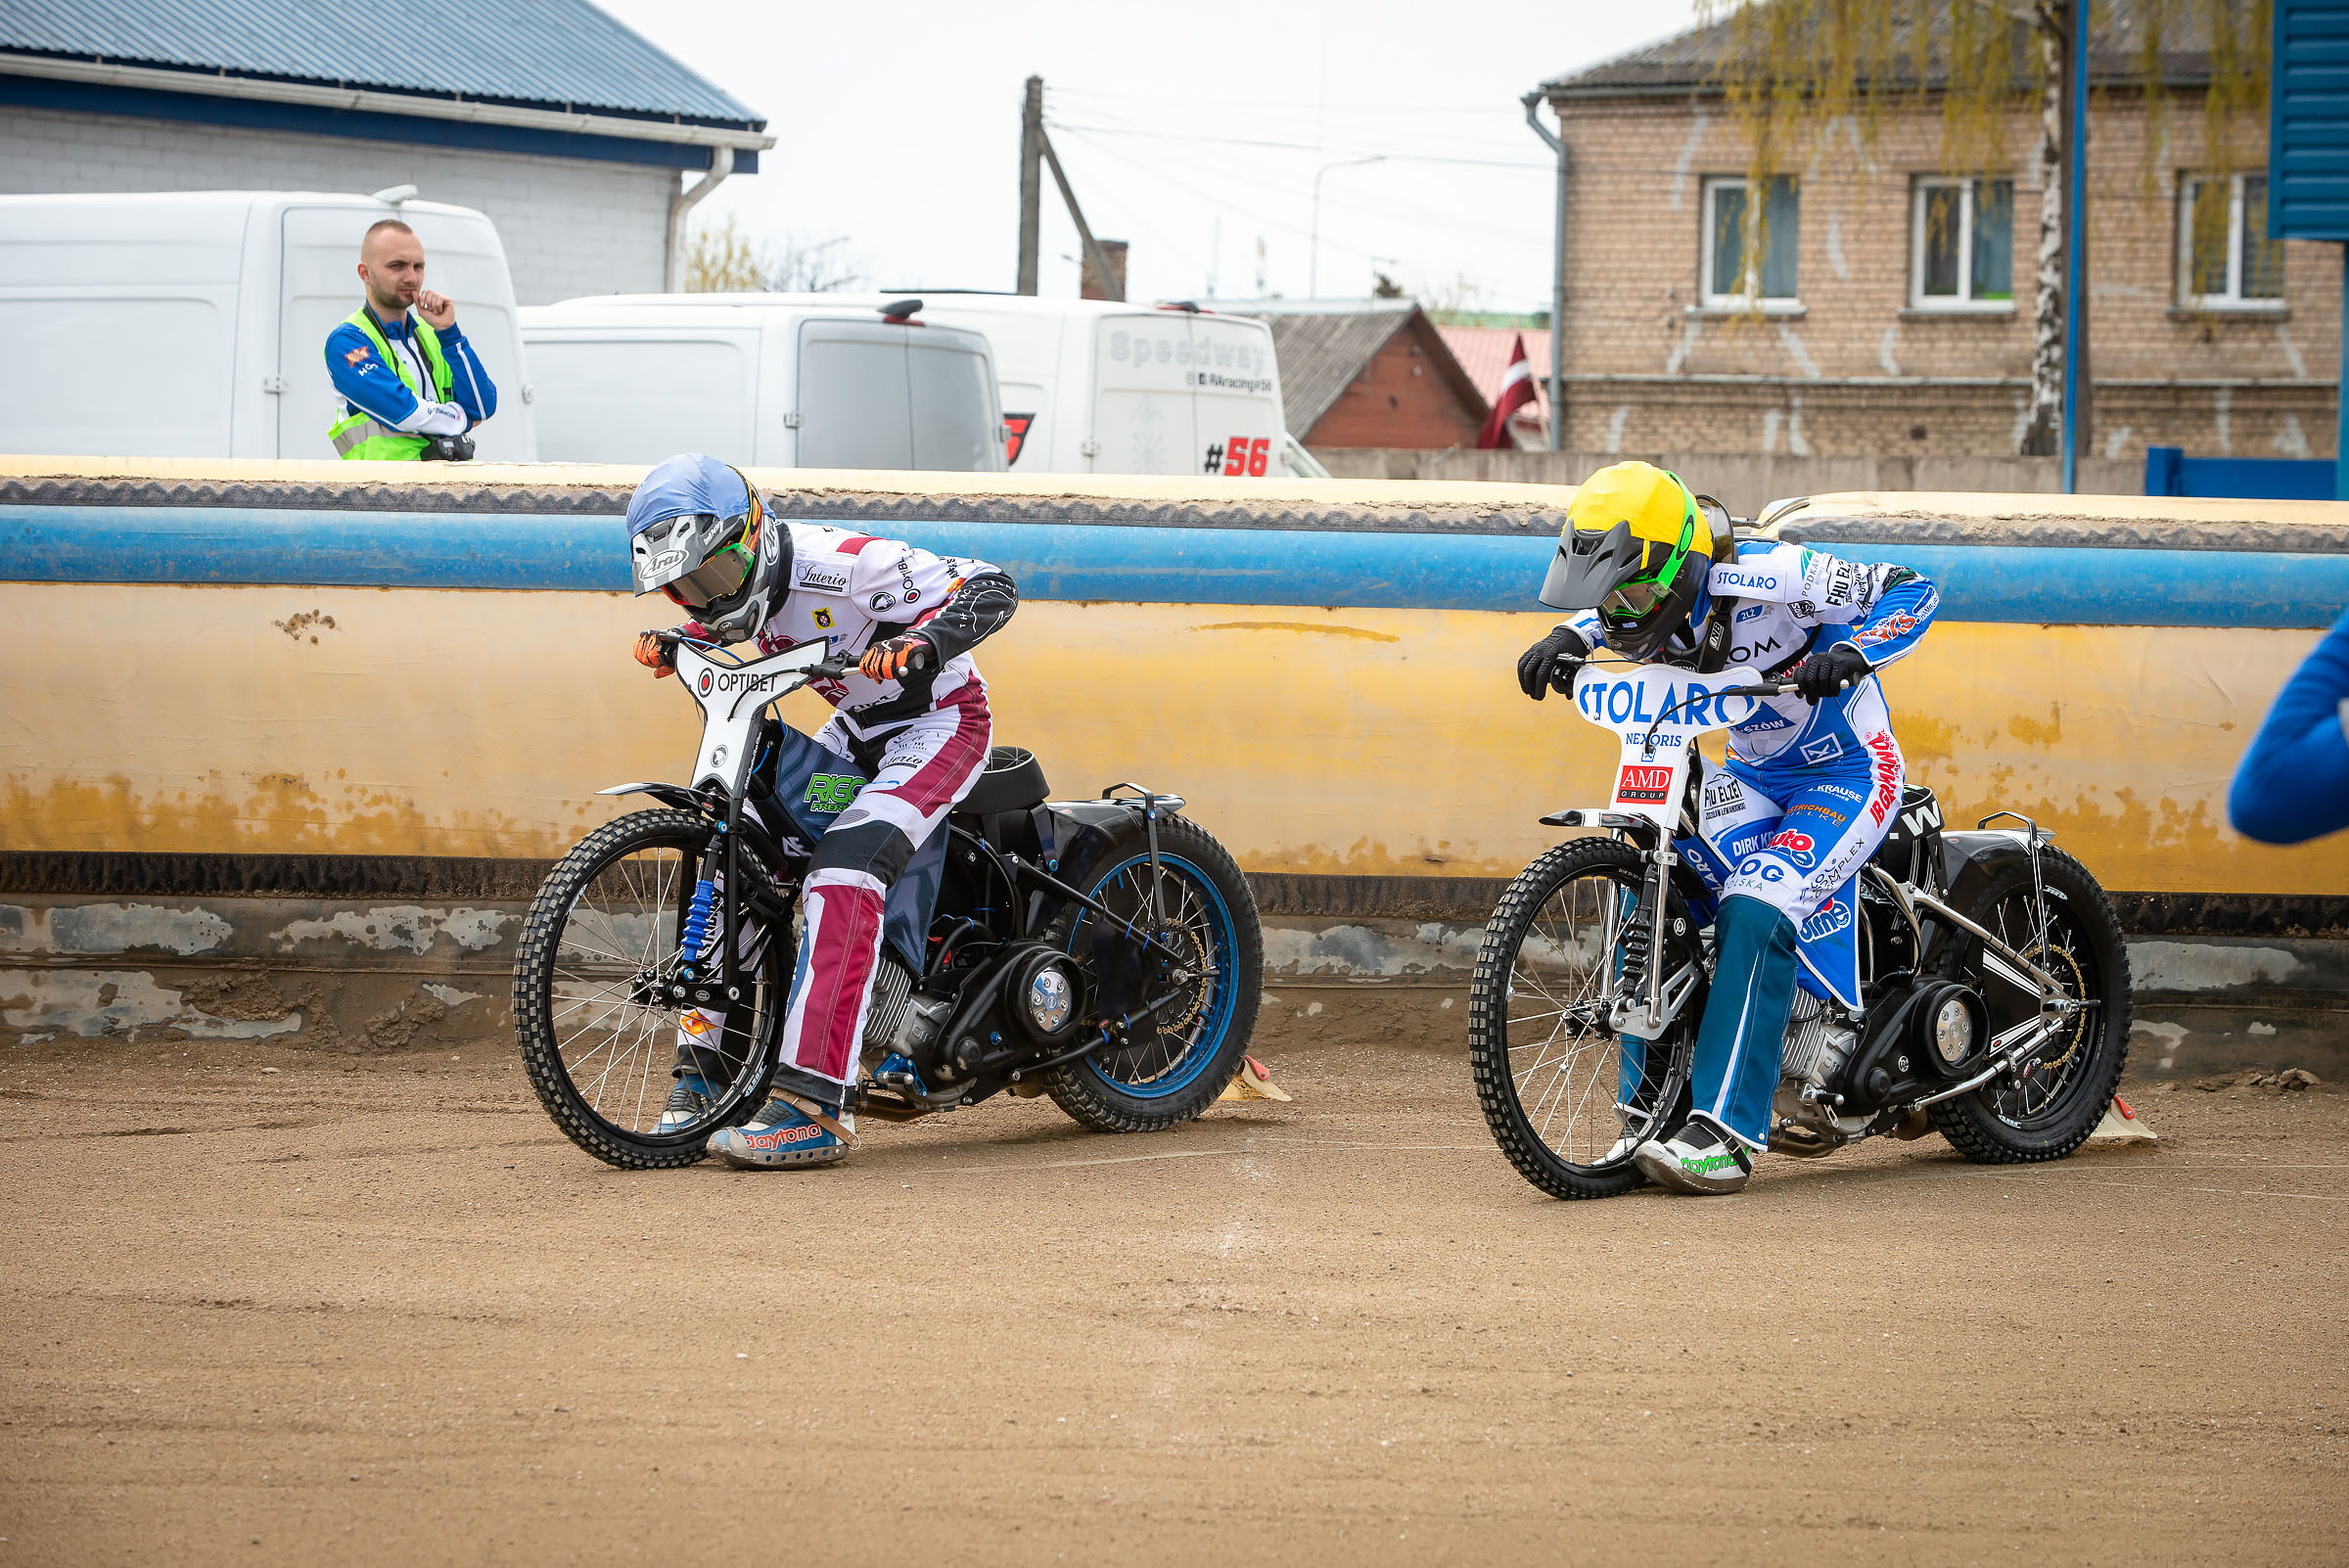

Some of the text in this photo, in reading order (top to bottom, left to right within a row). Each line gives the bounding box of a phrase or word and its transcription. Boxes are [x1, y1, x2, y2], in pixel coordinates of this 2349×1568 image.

[1110, 330, 1266, 375] Speedway
[1204, 437, 1270, 477] #56
[649, 551, 680, 574] Arai
[797, 562, 848, 587] Interio
[1717, 572, 1776, 590] STOLARO
[1825, 579, 1851, 607] FHU
[1727, 635, 1781, 664] OM
[718, 672, 778, 692] OPTIBET
[1626, 733, 1682, 748] NEXORIS
[1621, 769, 1671, 790] AMD
[1621, 790, 1665, 800] GROUP
[1818, 784, 1864, 804] KRAUSE
[1786, 804, 1847, 823] STRICHBAU
[1732, 835, 1760, 857] DIRK
[1686, 848, 1724, 899] LARO
[745, 1124, 823, 1151] daytona
